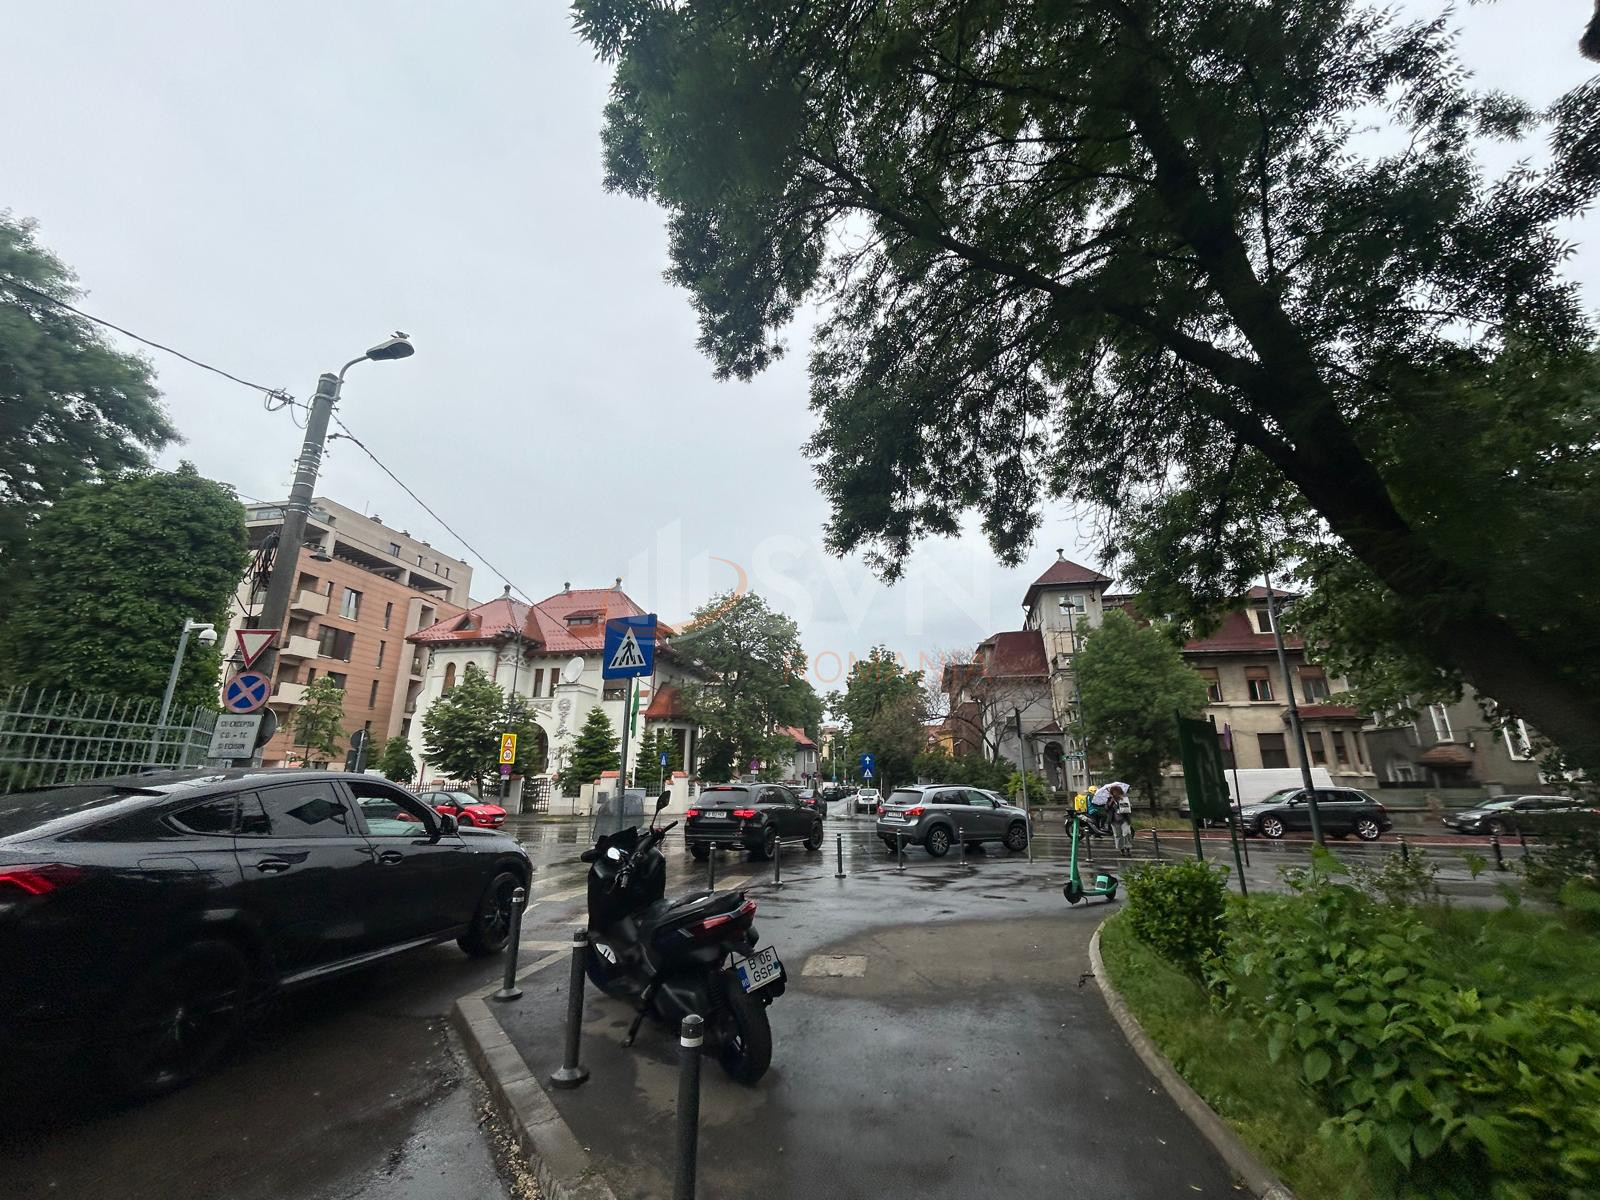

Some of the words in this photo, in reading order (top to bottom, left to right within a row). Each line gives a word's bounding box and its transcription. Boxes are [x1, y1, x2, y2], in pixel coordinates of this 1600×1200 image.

[748, 959, 757, 970] B
[759, 951, 771, 964] 06
[753, 963, 773, 982] GSP
